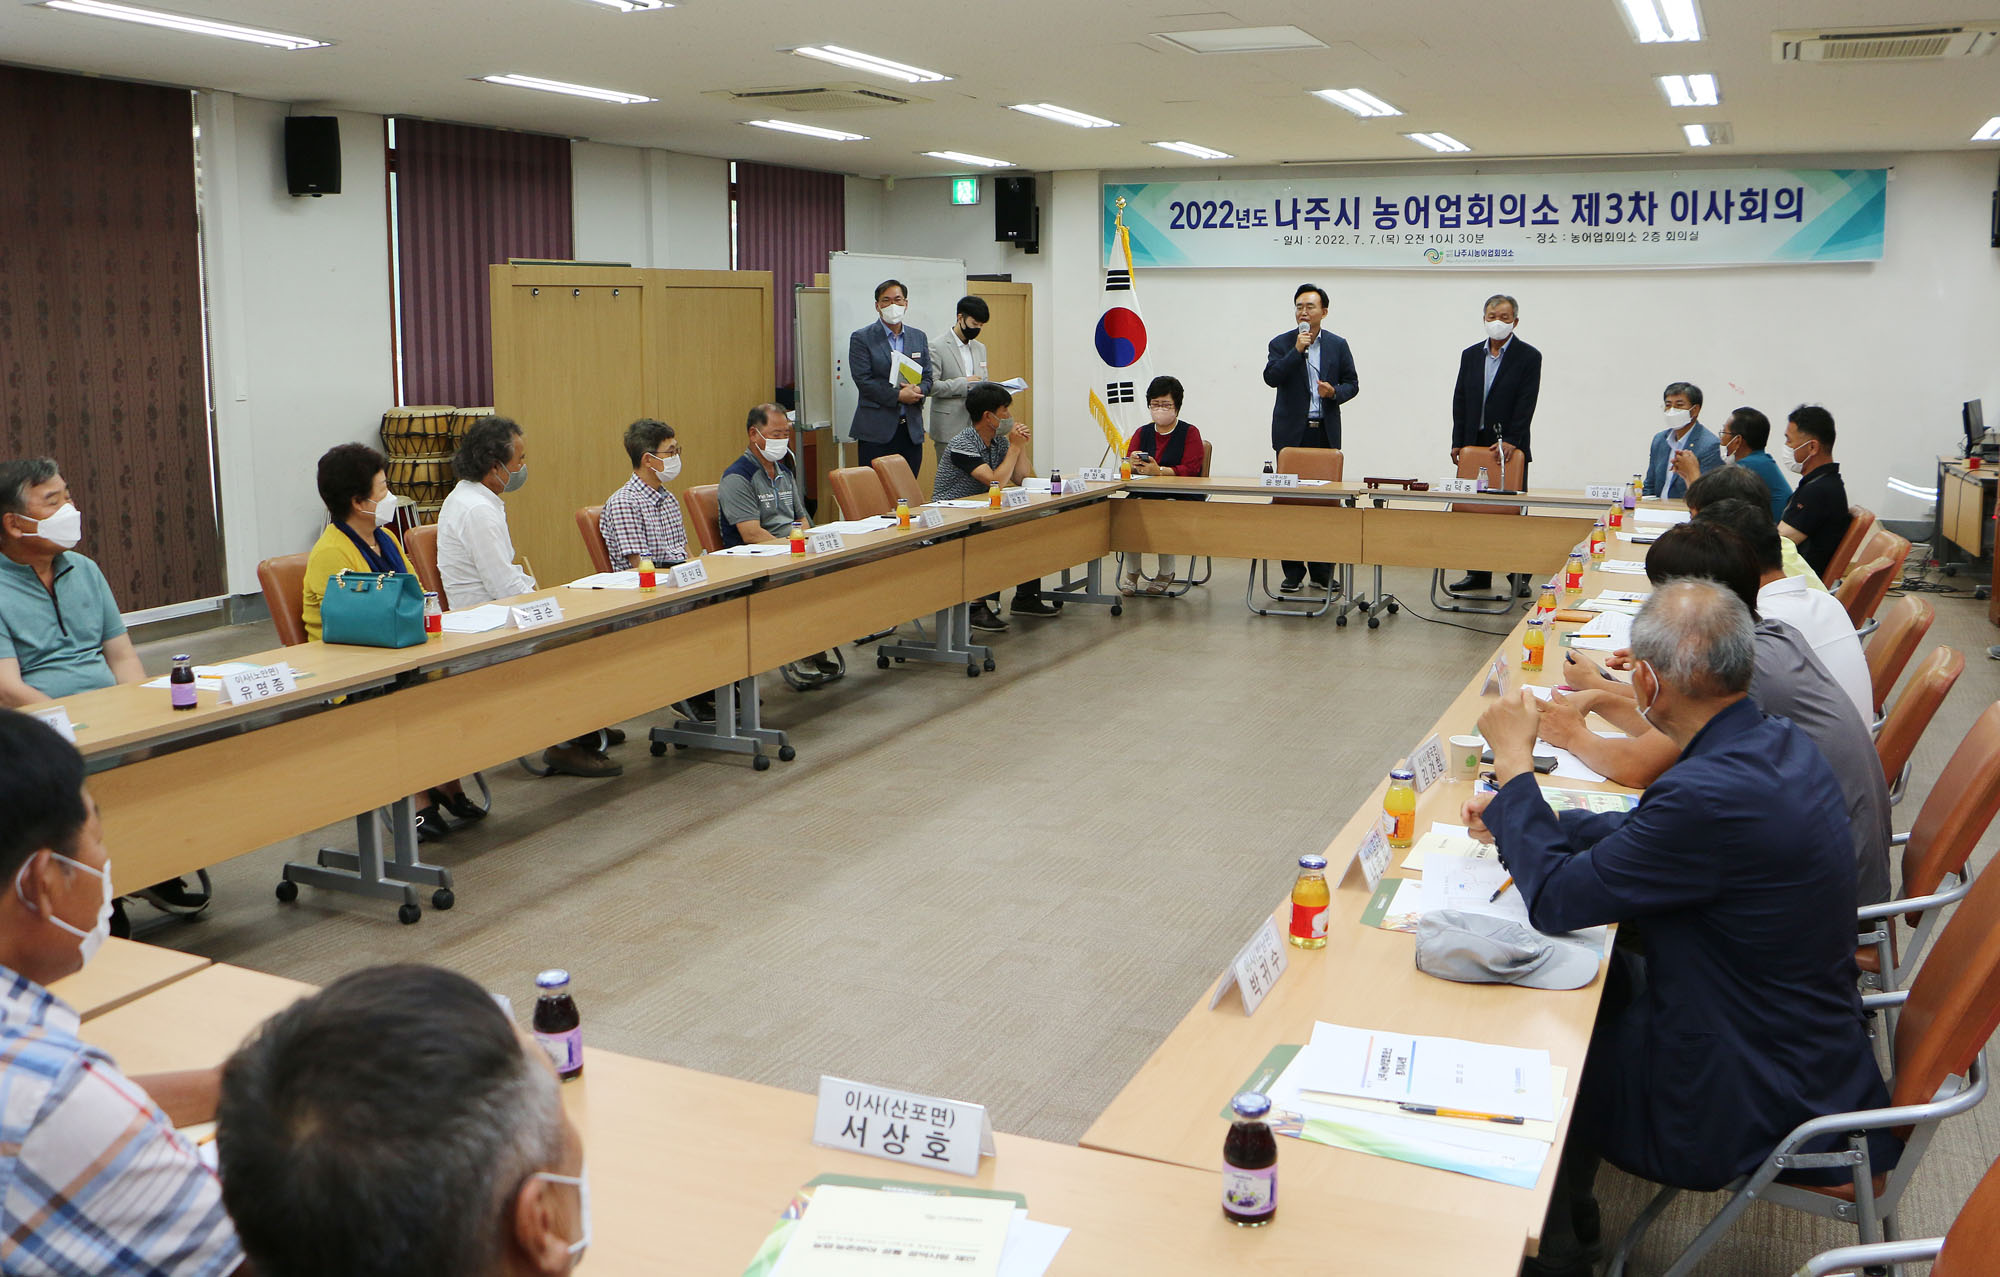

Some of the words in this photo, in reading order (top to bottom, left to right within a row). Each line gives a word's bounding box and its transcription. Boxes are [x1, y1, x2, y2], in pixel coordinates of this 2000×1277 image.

[1169, 200, 1268, 230] 2022년도
[1275, 196, 1361, 230] 나주시
[1372, 192, 1560, 230] 농어업회의소
[1571, 190, 1658, 227] 제3차
[1670, 186, 1804, 224] 이사회의
[1283, 235, 1303, 246] 일시
[1315, 235, 1349, 245] 2022.
[1404, 234, 1425, 245] 오전
[1429, 233, 1454, 244] 10시
[1458, 233, 1485, 244] 30분
[1536, 232, 1558, 244] 장소
[1570, 231, 1637, 244] 농어업회의소
[1642, 231, 1661, 242] 2층
[1665, 230, 1699, 242] 회의실
[1249, 949, 1280, 996] 박귀수
[845, 1090, 956, 1129] 이사(산포면)
[841, 1115, 951, 1163] 서상호
